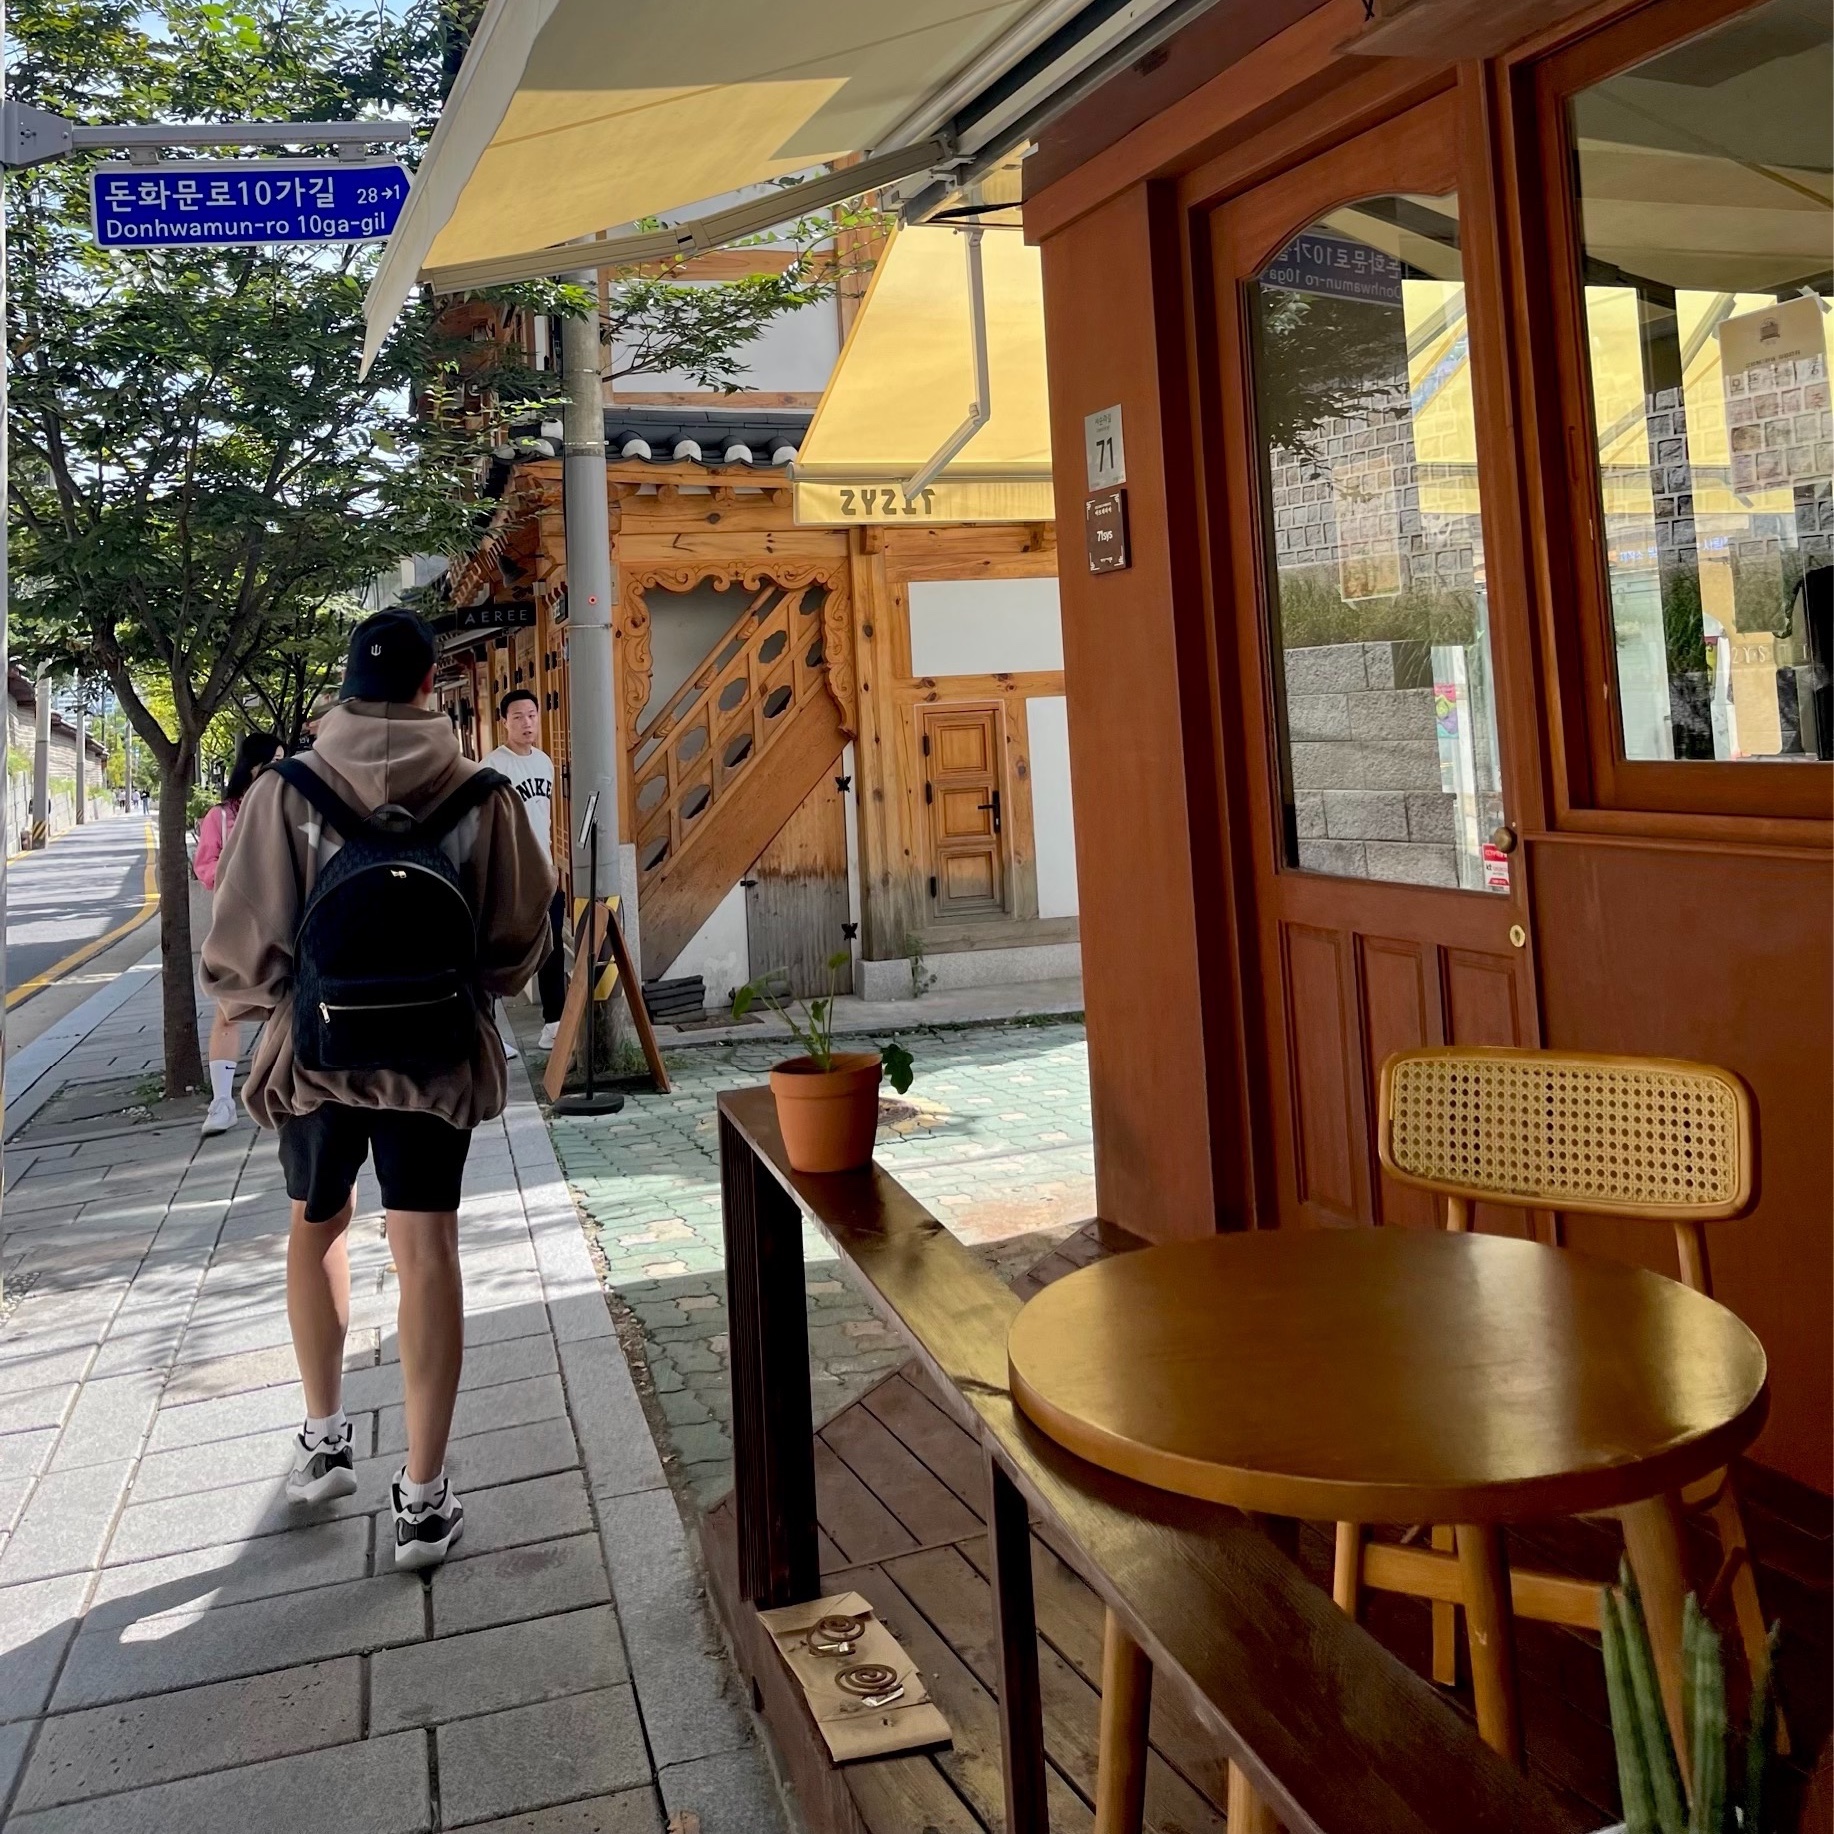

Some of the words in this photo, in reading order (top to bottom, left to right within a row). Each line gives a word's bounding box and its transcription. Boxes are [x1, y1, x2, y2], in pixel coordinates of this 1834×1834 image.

[104, 176, 335, 212] 돈화문로10가길
[106, 217, 290, 239] Donhwamun-ro
[297, 211, 385, 237] 10ga-gil
[1096, 437, 1114, 473] 71
[464, 609, 528, 625] AEREE
[515, 777, 552, 802] NIKE
